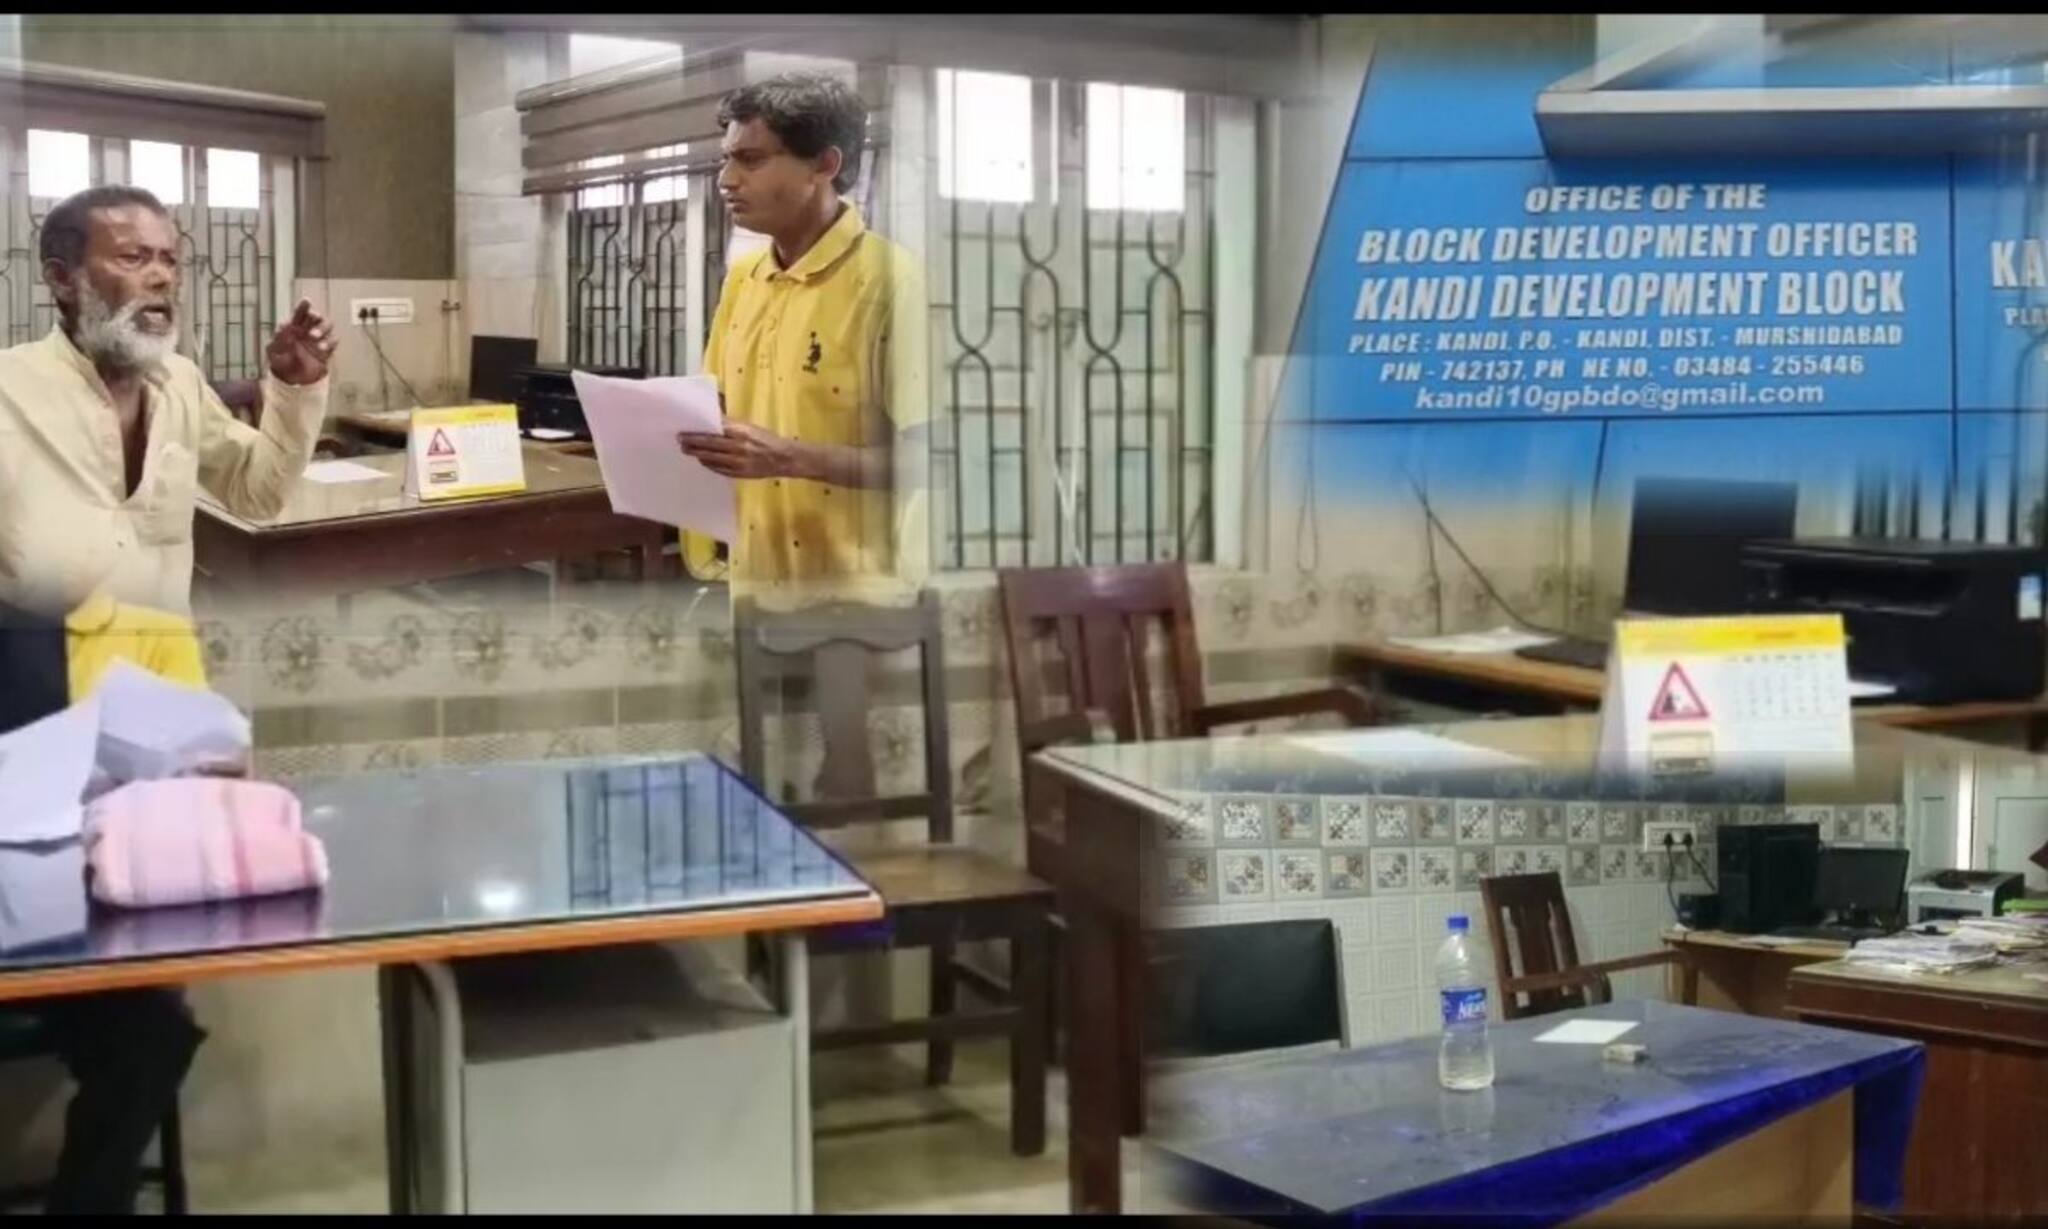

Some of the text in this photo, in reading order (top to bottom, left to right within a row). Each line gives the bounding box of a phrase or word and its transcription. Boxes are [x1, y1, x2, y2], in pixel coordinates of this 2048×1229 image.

[1525, 184, 1767, 213] OFFICE OF THE
[1357, 222, 1918, 263] BLOCK DEVELOPMENT OFFICER
[1991, 239, 2048, 287] KA
[1354, 270, 1905, 321] KANDI DEVELOPMENT BLOCK
[1659, 327, 1715, 348] DIST.
[1735, 325, 1903, 346] MURSHIDABAD
[1380, 361, 1422, 382] PIN
[1674, 355, 1753, 377] 03484
[1771, 354, 1865, 376] 255446
[1415, 381, 1825, 412] kandi10gpbdo@gmail.com
